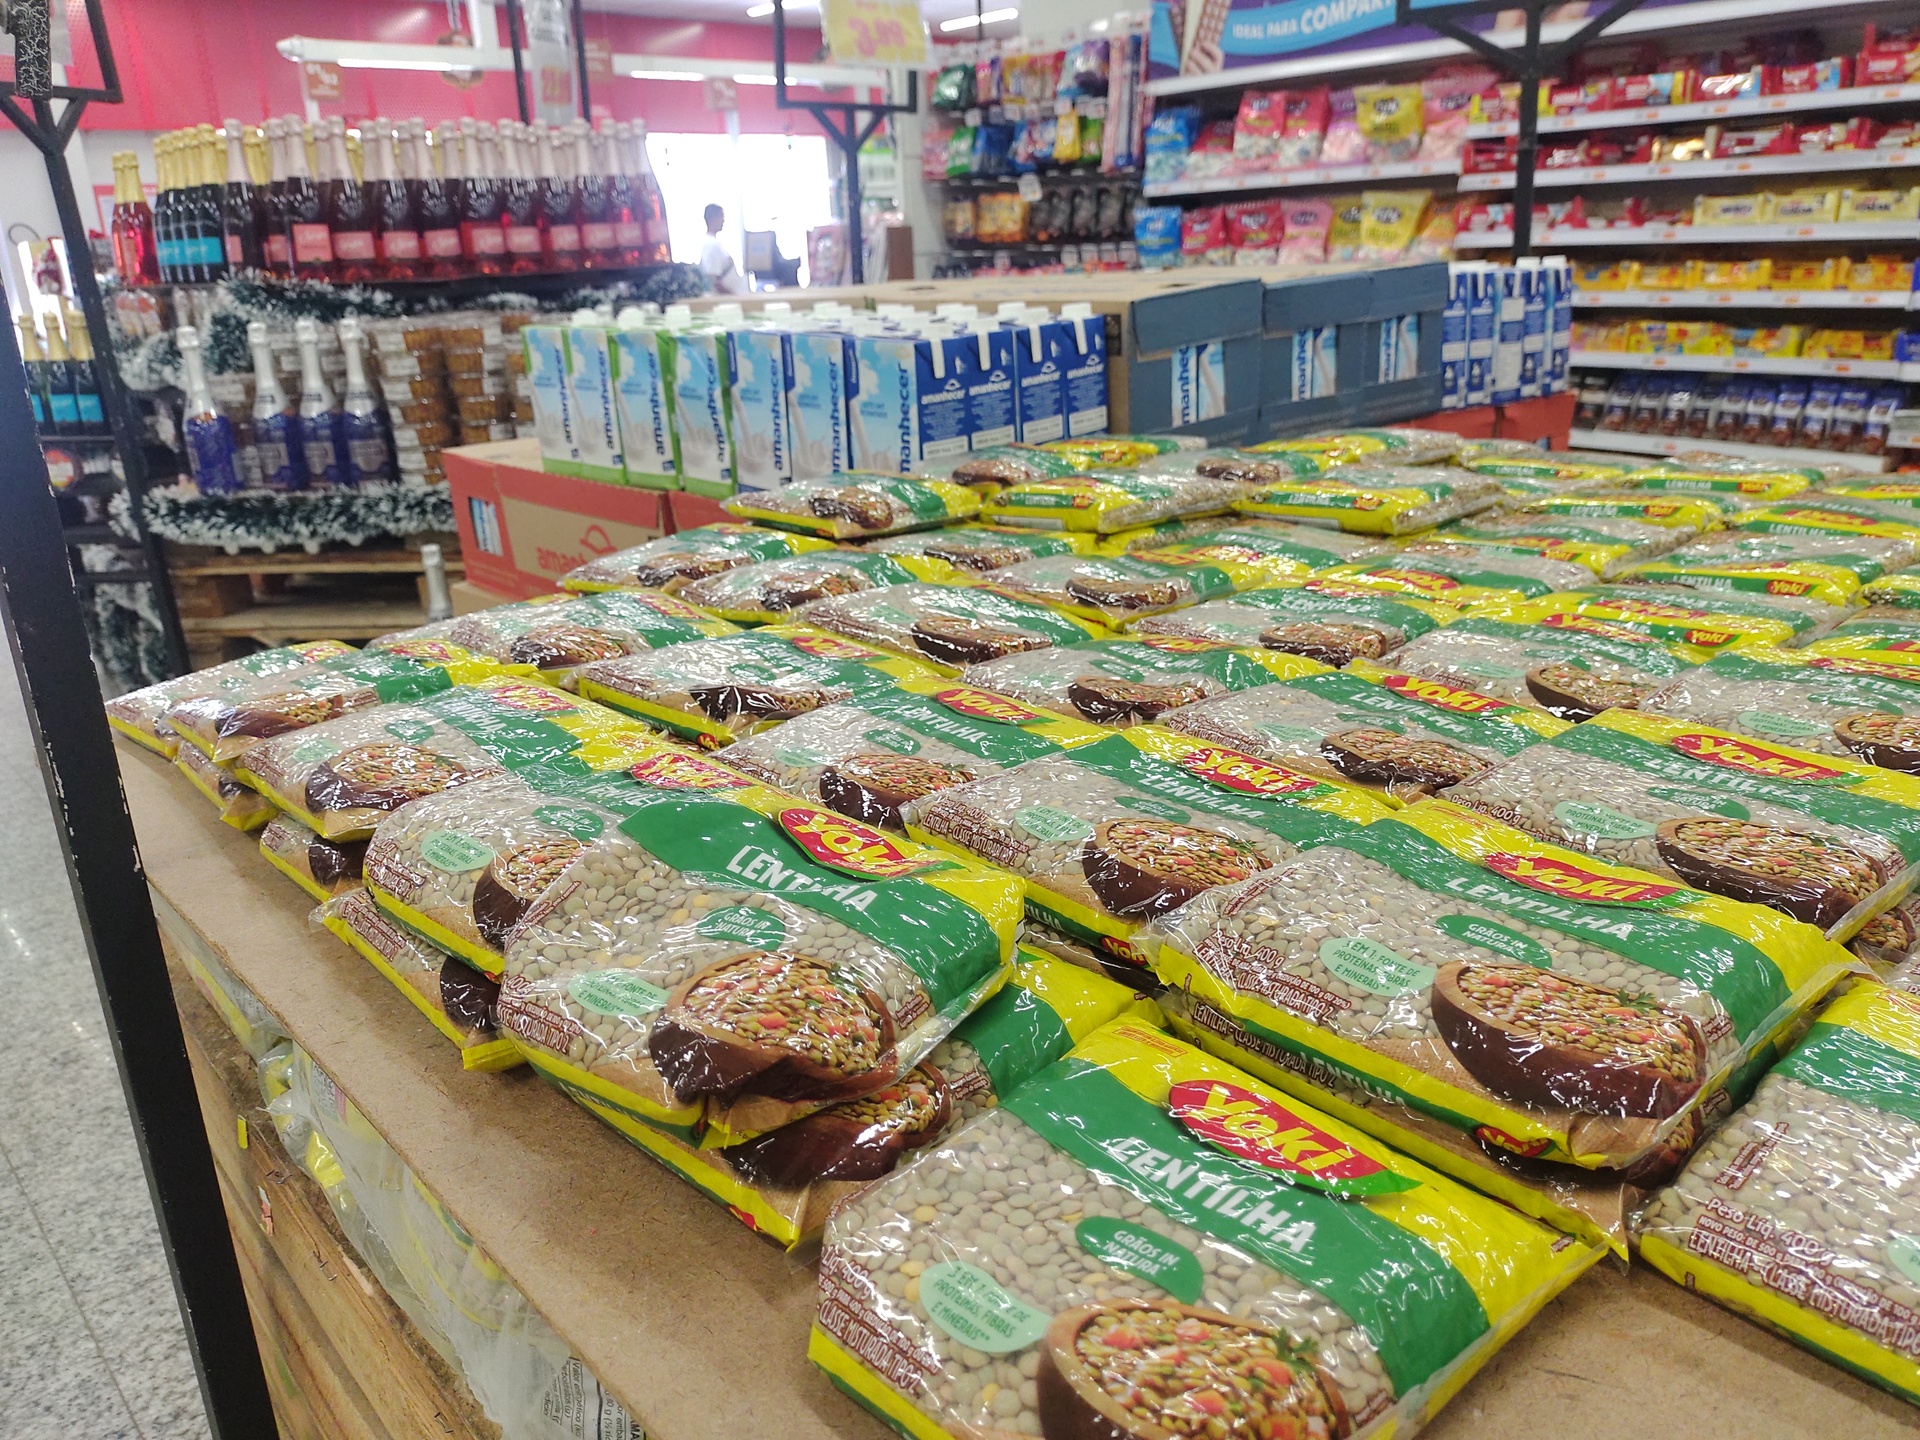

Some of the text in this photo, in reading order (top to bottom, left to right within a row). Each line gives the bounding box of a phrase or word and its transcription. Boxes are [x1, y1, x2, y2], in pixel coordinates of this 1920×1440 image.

[1232, 23, 1264, 40] IDEAL
[1266, 18, 1299, 37] PARA
[553, 346, 573, 445] amanhecer
[597, 349, 615, 450] amanhecer
[647, 351, 666, 455] amanhecer
[706, 352, 725, 463] amanhecer
[770, 355, 784, 471] amanhecer
[828, 357, 841, 474] manhecer
[897, 363, 911, 473] manhecer
[1771, 580, 1811, 596] Yoki
[1690, 630, 1730, 644] Yoki
[1350, 692, 1468, 733] LENTILHA
[1399, 676, 1494, 711] Yoki
[893, 704, 988, 744] LENTILHA
[1695, 736, 1820, 778] Yoki
[1137, 775, 1265, 819] LENTILHA
[1643, 758, 1814, 803] LENTILHA
[966, 806, 983, 820] 400
[1491, 805, 1514, 823] 400
[1513, 812, 1522, 826] g
[952, 825, 972, 846] CLASSE
[1504, 858, 1653, 900] Yoki
[1445, 876, 1635, 942] LENTILHA
[1024, 903, 1147, 962] TILHA Yok
[1468, 922, 1507, 943] GRÃOS
[1254, 945, 1275, 964] 400
[1275, 956, 1286, 969] g
[1334, 964, 1344, 973] E
[1350, 941, 1370, 955] EM
[1376, 955, 1408, 974] FONTE
[1405, 967, 1421, 977] DE
[508, 975, 527, 994] 400
[1382, 970, 1411, 987] FIBRAS
[1322, 1006, 1335, 1022] 2
[1332, 996, 1352, 1009] 20%)
[1193, 1004, 1338, 1089] LENTILHA CLASSE MISTURADA TIPO 2
[1301, 1051, 1406, 1107] ENTILHA
[1185, 1082, 1357, 1173] Yoki
[1110, 1136, 1317, 1253] LENTILHA
[1707, 1198, 1745, 1223] Peso
[1746, 1215, 1775, 1240] Líq.
[1780, 1231, 1821, 1255] 400
[1112, 1229, 1181, 1268] GRÃOS IN
[1699, 1215, 1723, 1232] NOVO
[1722, 1226, 1746, 1243] PESO:
[1745, 1236, 1759, 1248] DE
[1758, 1242, 1777, 1256] 500
[1878, 1298, 1892, 1311] DE
[1893, 1304, 1911, 1320] 100
[842, 1260, 869, 1289] 400
[947, 1265, 961, 1278] 3
[958, 1271, 979, 1288] EM
[1013, 1310, 1031, 1323] DE
[1689, 1229, 1752, 1273] LENTILHA
[1810, 1286, 1888, 1339] MISTURADA
[930, 1301, 943, 1313] E
[981, 1309, 1017, 1338] FIBRAS
[820, 1299, 923, 1395] CLASSE MISTURADA TIPO 2
[572, 1361, 582, 1383] Valor
